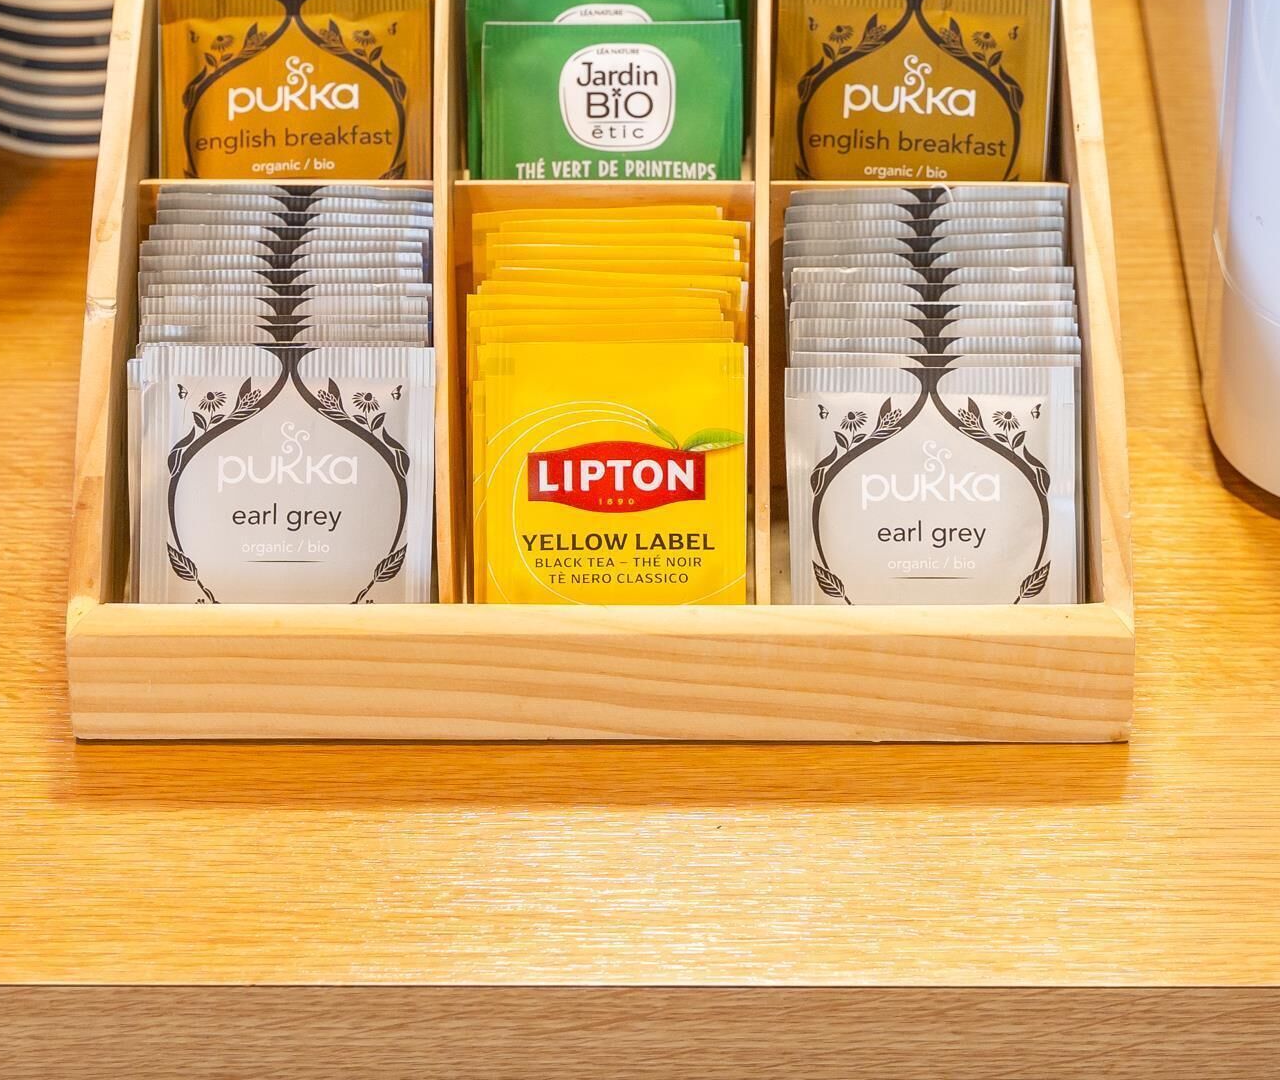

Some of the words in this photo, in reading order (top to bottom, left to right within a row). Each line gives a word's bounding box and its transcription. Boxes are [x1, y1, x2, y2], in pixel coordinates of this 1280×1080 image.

[577, 61, 658, 87] Jardin
[228, 56, 359, 121] pukka
[843, 54, 977, 119] pukka
[195, 128, 276, 155] english
[284, 125, 393, 148] breakfast
[808, 128, 890, 155] english
[898, 131, 1007, 157] breakfast
[251, 157, 301, 175] organic
[313, 157, 336, 171] bio
[515, 158, 546, 180] THÉ
[551, 160, 592, 179] VERT
[598, 159, 619, 178] DE
[624, 159, 718, 180] PRINTEMPS
[864, 164, 913, 180] organic
[925, 165, 948, 179] bio
[537, 458, 696, 493] LIPTON
[598, 497, 635, 506] 1890
[232, 502, 277, 526] earl
[286, 510, 342, 532] grey
[522, 533, 628, 552] YELLOW
[635, 533, 715, 551] LABEL
[877, 519, 922, 542] earl
[931, 527, 987, 549] grey
[241, 541, 294, 557] organic
[307, 540, 330, 553] bio
[535, 557, 583, 568] BLACK
[587, 557, 615, 568] TEA
[633, 554, 661, 568] THÉ
[666, 557, 702, 568] NOIR
[887, 557, 939, 573] organic
[953, 557, 976, 569] bio
[549, 572, 567, 584] TÈ
[571, 573, 612, 584] NERO
[616, 573, 689, 584] CLASSICO
